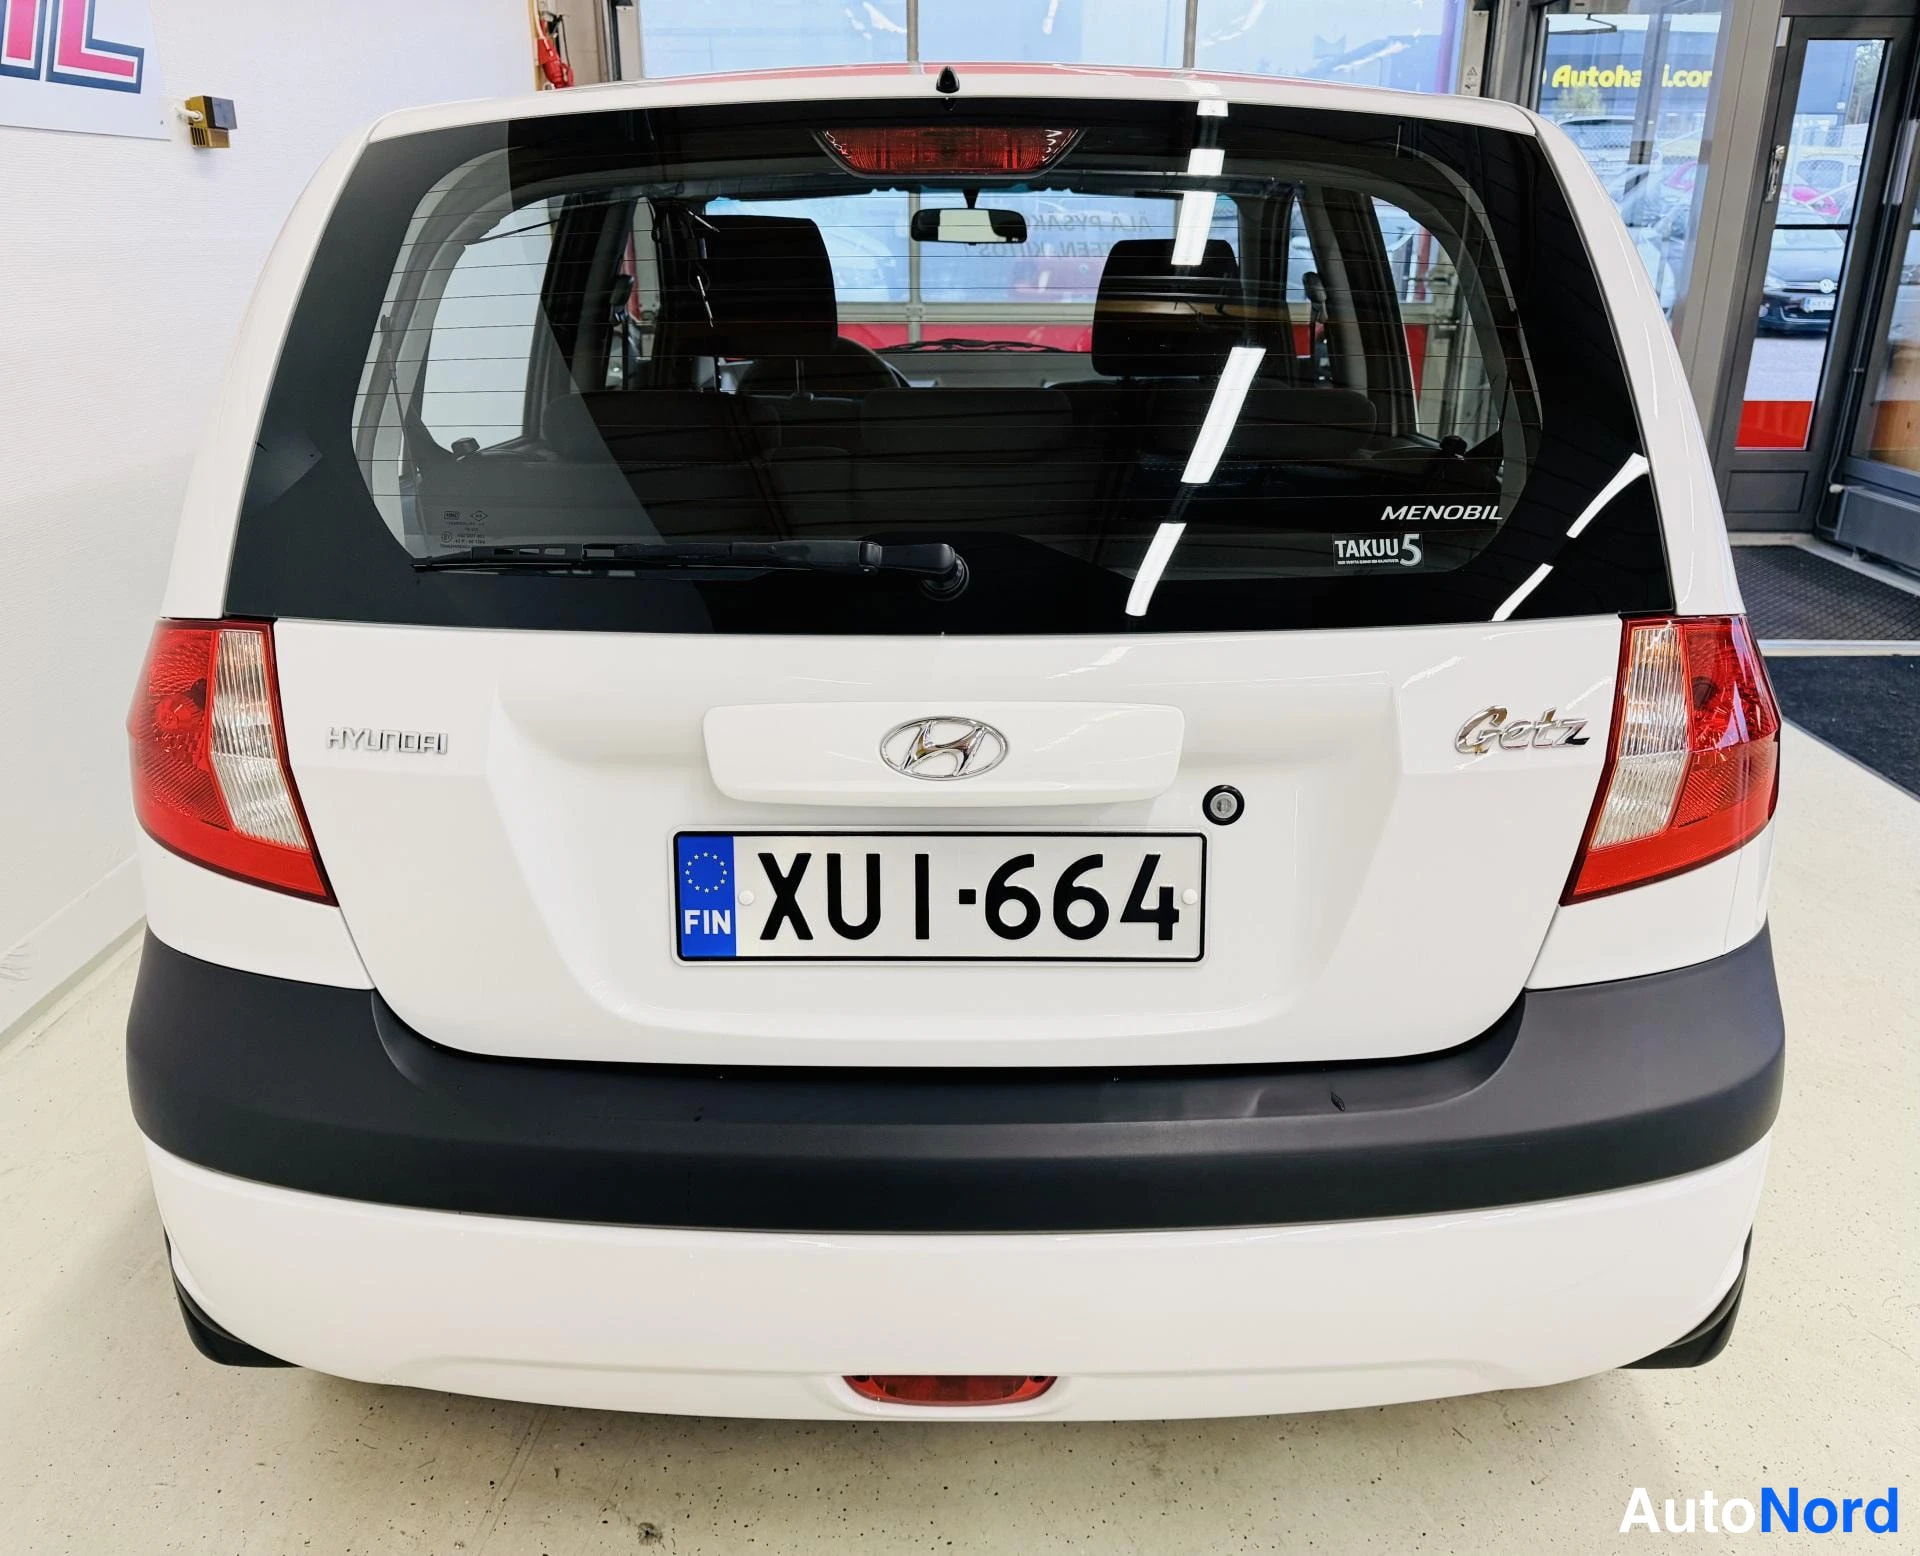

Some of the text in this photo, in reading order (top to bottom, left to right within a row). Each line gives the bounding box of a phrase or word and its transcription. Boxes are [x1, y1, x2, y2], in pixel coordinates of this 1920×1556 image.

[1381, 505, 1503, 521] MENOBIL
[1334, 538, 1399, 558] TAKUU
[326, 727, 448, 754] HYUNDAI
[1455, 705, 1590, 754] Getz
[757, 853, 1180, 940] XUI-664
[684, 909, 731, 934] FIN
